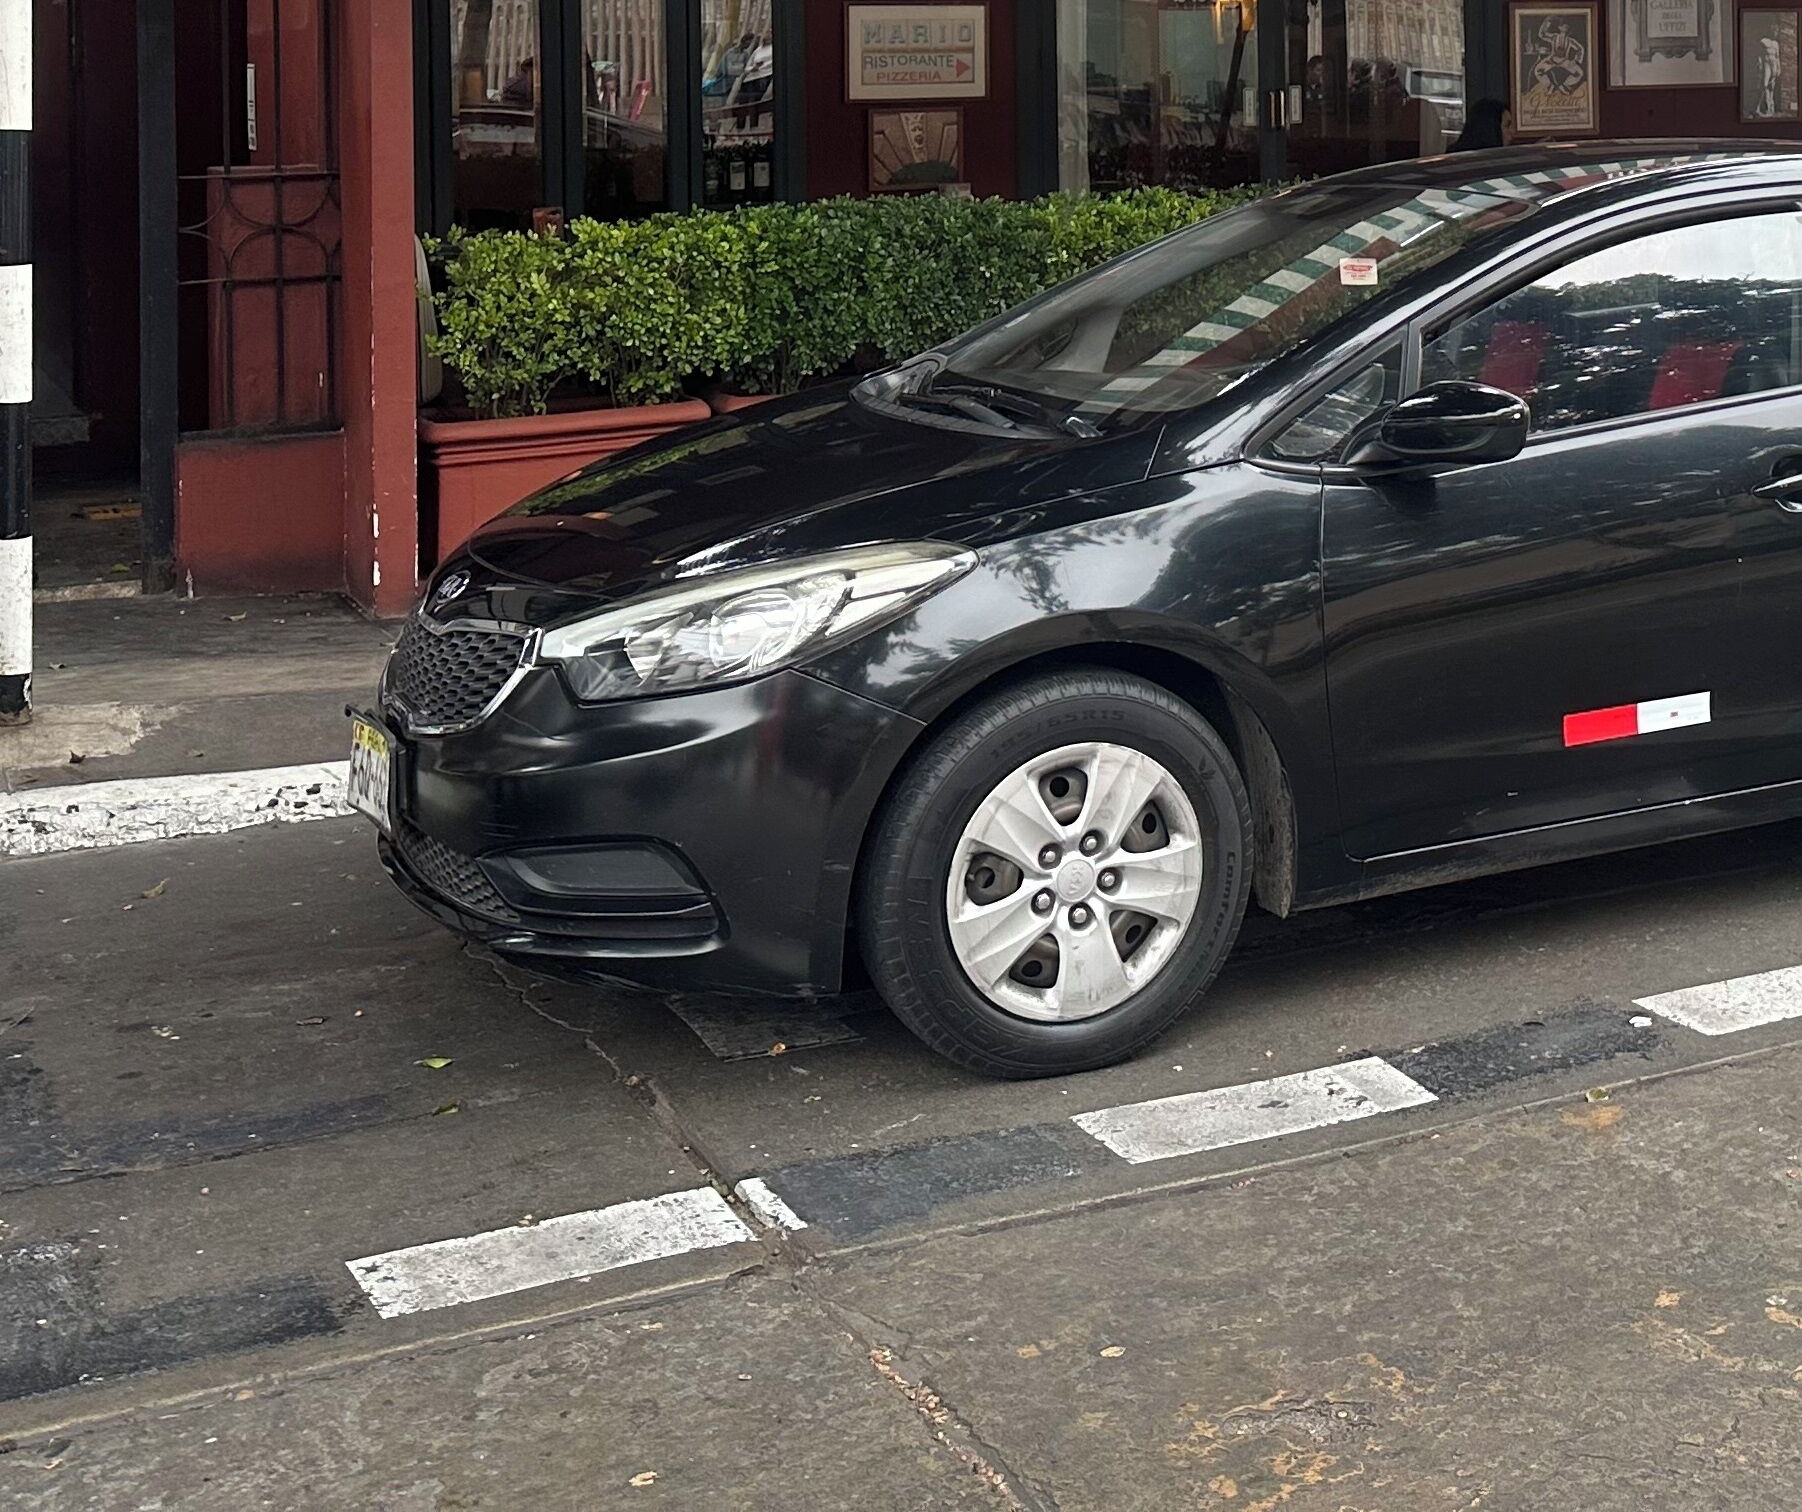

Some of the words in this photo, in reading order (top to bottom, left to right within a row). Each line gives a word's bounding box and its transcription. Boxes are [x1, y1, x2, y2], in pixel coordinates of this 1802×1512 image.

[863, 23, 973, 45] MARIO
[862, 54, 956, 70] RISTORANTE
[876, 70, 942, 84] PIZZERIA
